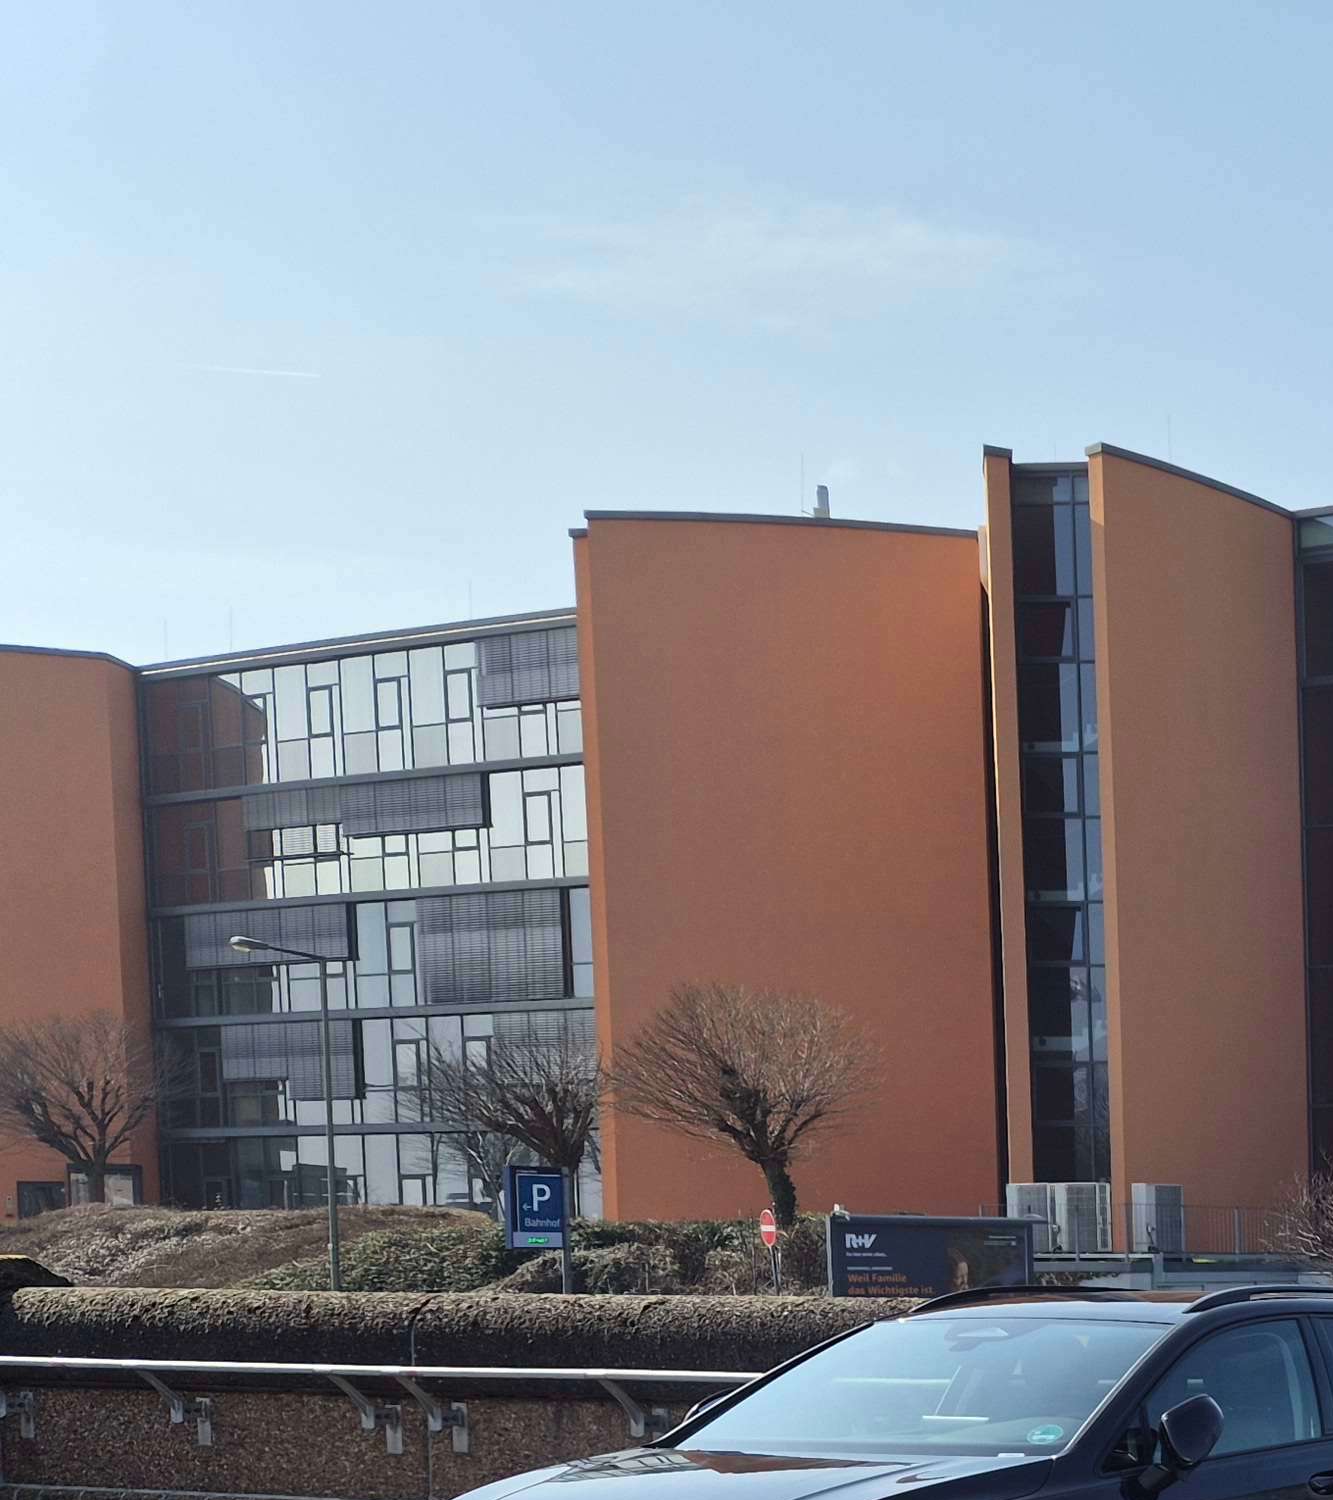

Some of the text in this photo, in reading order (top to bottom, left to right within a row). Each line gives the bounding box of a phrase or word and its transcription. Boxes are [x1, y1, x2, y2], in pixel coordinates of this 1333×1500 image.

[532, 1184, 551, 1212] P
[524, 1217, 560, 1227] Bahnhof
[845, 1233, 877, 1249] R+V
[848, 1273, 907, 1283] Weil Familie
[848, 1286, 865, 1295] das
[868, 1286, 919, 1297] Wichtigste
